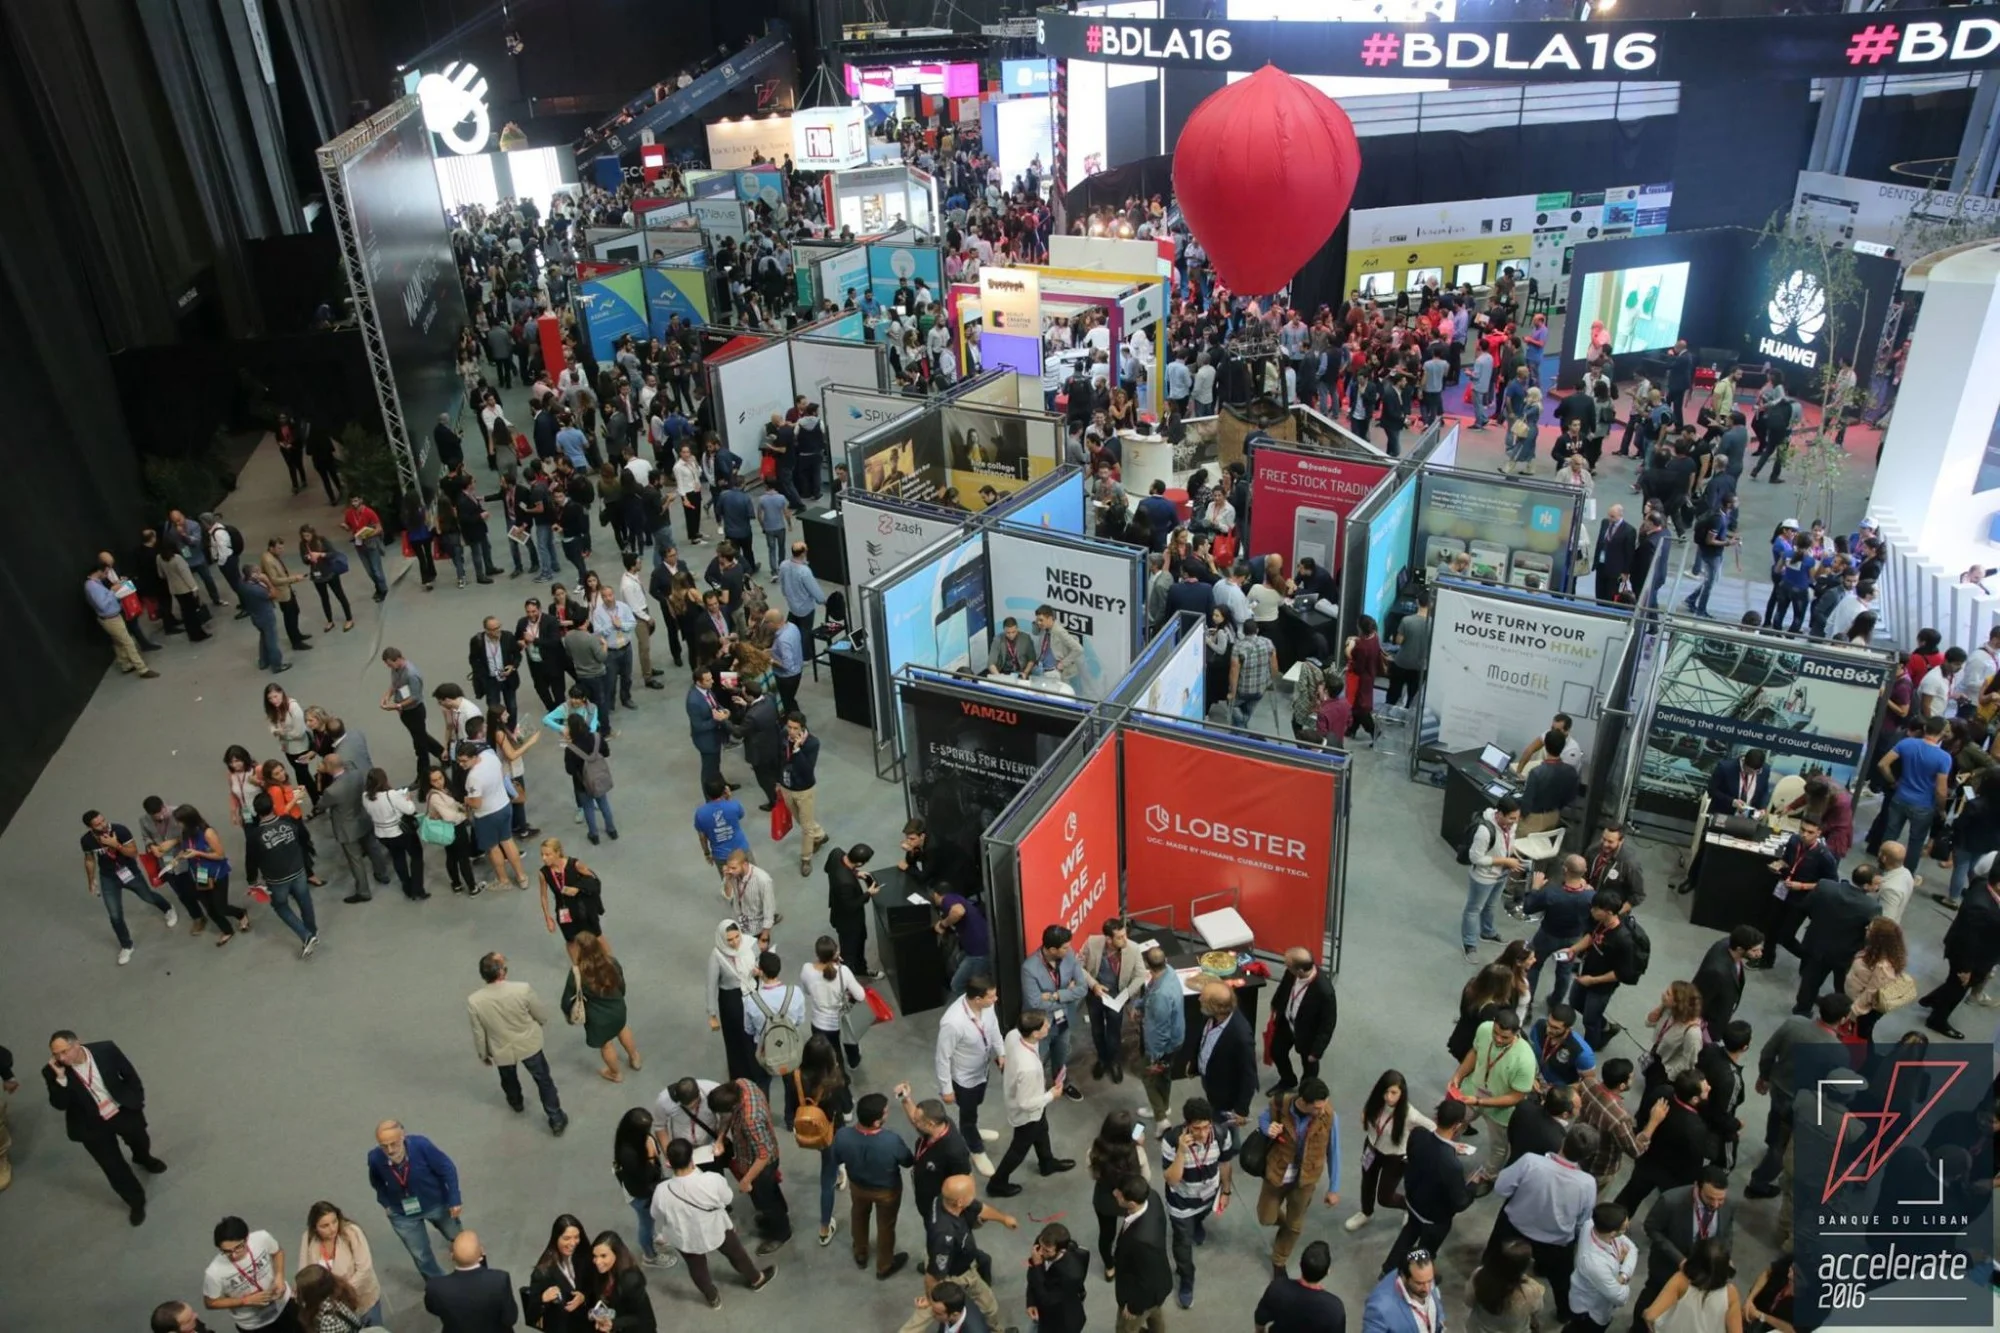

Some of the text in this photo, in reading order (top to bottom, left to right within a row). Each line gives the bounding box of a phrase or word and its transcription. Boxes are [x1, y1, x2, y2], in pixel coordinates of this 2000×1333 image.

[1087, 24, 1232, 61] #BDLA16
[1361, 32, 1657, 70] #BDLA16
[1759, 337, 1817, 368] HUAWEI
[987, 461, 1016, 473] college
[1260, 468, 1288, 484] FREE
[1291, 473, 1327, 490] STOCK
[894, 522, 923, 537] zash
[1046, 566, 1093, 590] NEED
[1047, 584, 1127, 615] MONEY?
[1454, 622, 1507, 642] HOUSE
[1509, 633, 1546, 650] INTO
[1471, 609, 1585, 642] WE TURN YOUR
[960, 701, 1018, 725] YAMZU
[1657, 710, 1853, 759] Defining the real value of crowd delivery
[929, 742, 977, 764] E-SPORTS
[978, 753, 998, 769] FOR
[940, 758, 954, 768] Play
[965, 764, 978, 774] free
[1174, 813, 1307, 861] LOBSTER
[1061, 838, 1085, 880] WE
[1146, 835, 1310, 879] UGC. MADE BY HUMANS. CURATED BY TECH.
[1060, 864, 1089, 919] ARE
